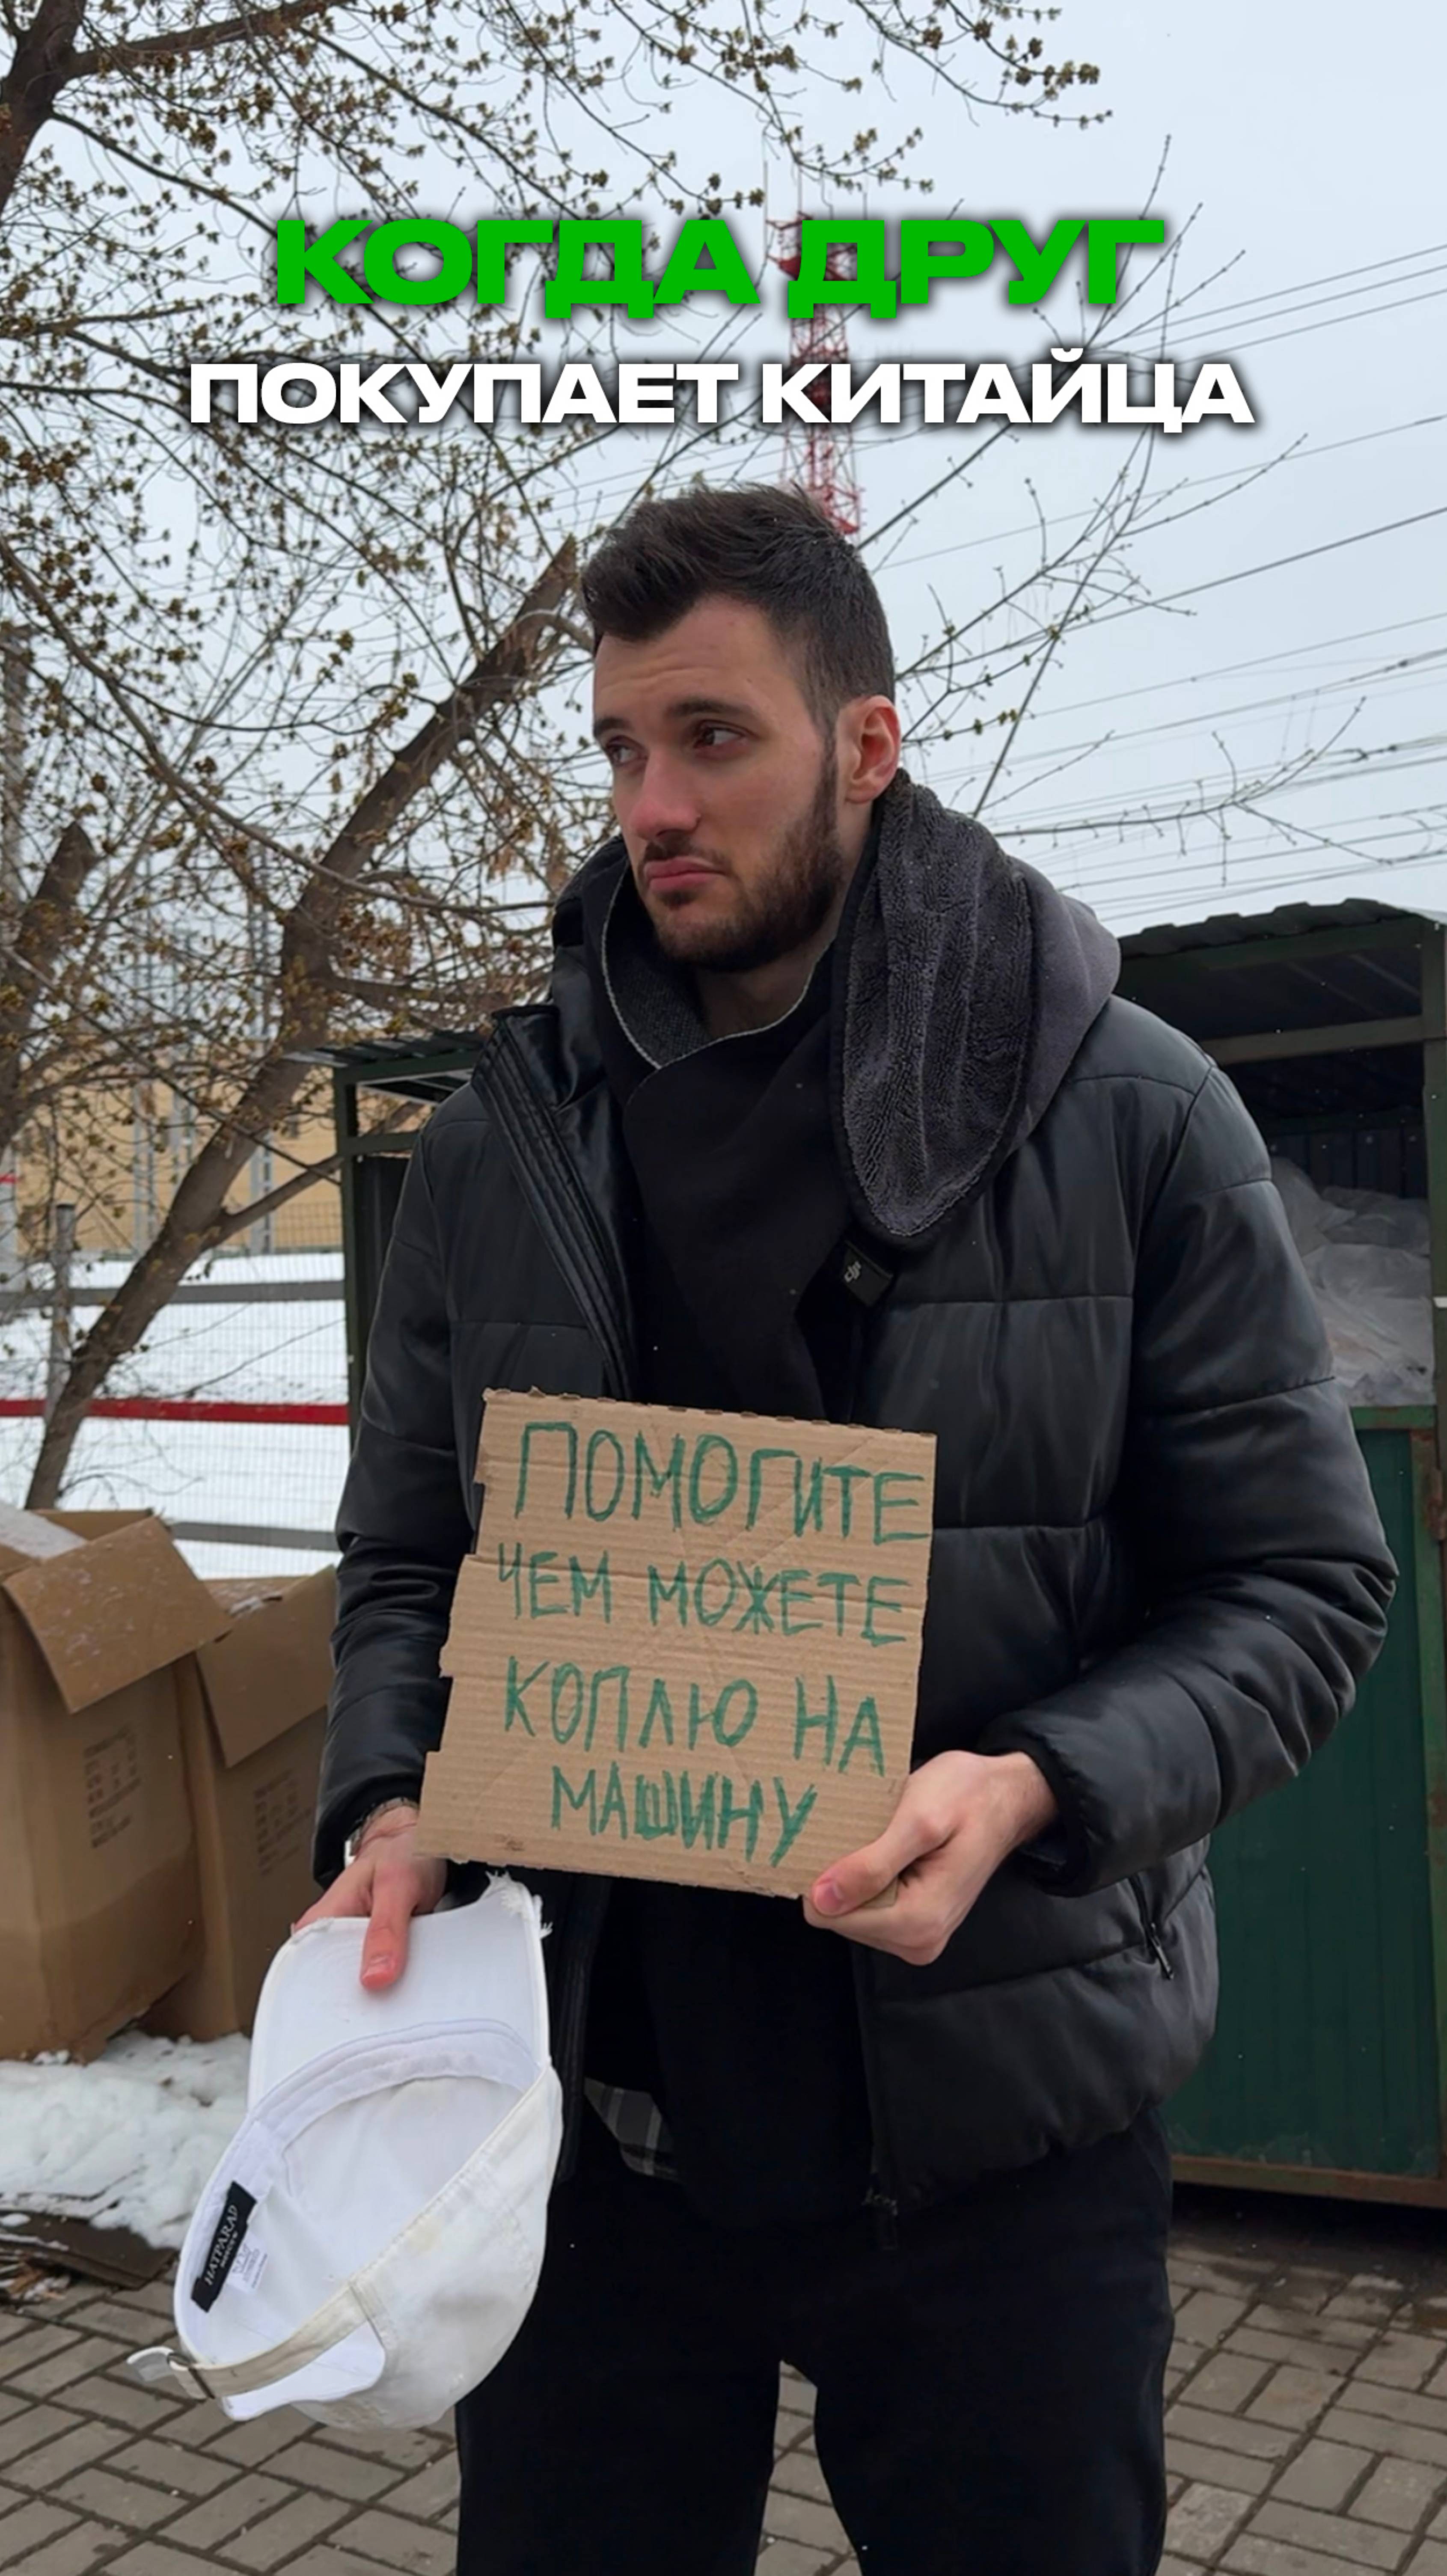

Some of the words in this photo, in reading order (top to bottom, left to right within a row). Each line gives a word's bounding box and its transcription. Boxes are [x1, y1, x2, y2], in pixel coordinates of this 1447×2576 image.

[514, 1421, 930, 1545] ПОМОГИТЕ
[499, 1542, 611, 1623] ЧЕМ
[648, 1558, 912, 1647] МОЖЕТЕ
[504, 1655, 758, 1753] КОПЛЮ
[794, 1674, 885, 1777] НА
[550, 1761, 818, 1867] МАШИНУ
[204, 2205, 238, 2286] HATPARAD
